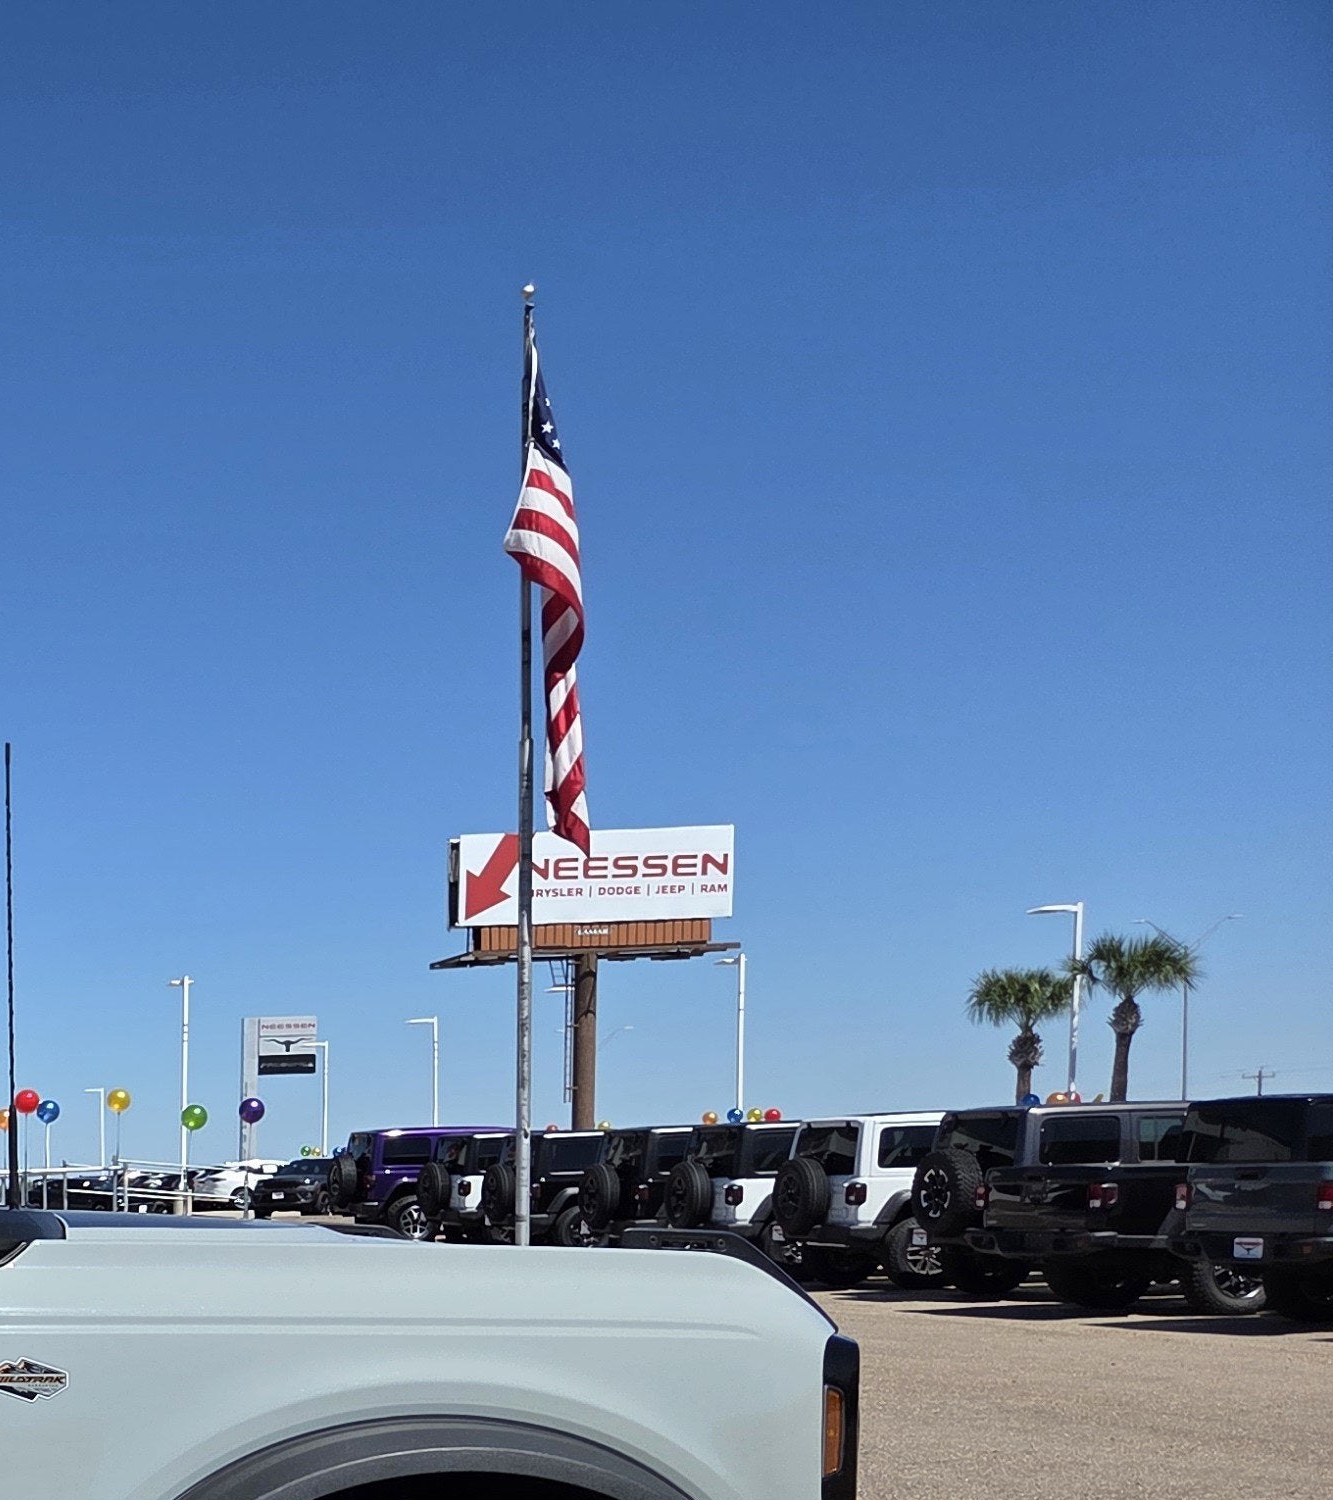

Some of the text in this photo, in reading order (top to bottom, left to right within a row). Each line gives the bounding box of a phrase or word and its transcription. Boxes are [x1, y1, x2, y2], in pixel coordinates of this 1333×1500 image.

[532, 852, 729, 881] NEESSEN
[598, 885, 641, 896] DODGE
[655, 884, 686, 895] JEEP
[700, 883, 728, 894] RAM
